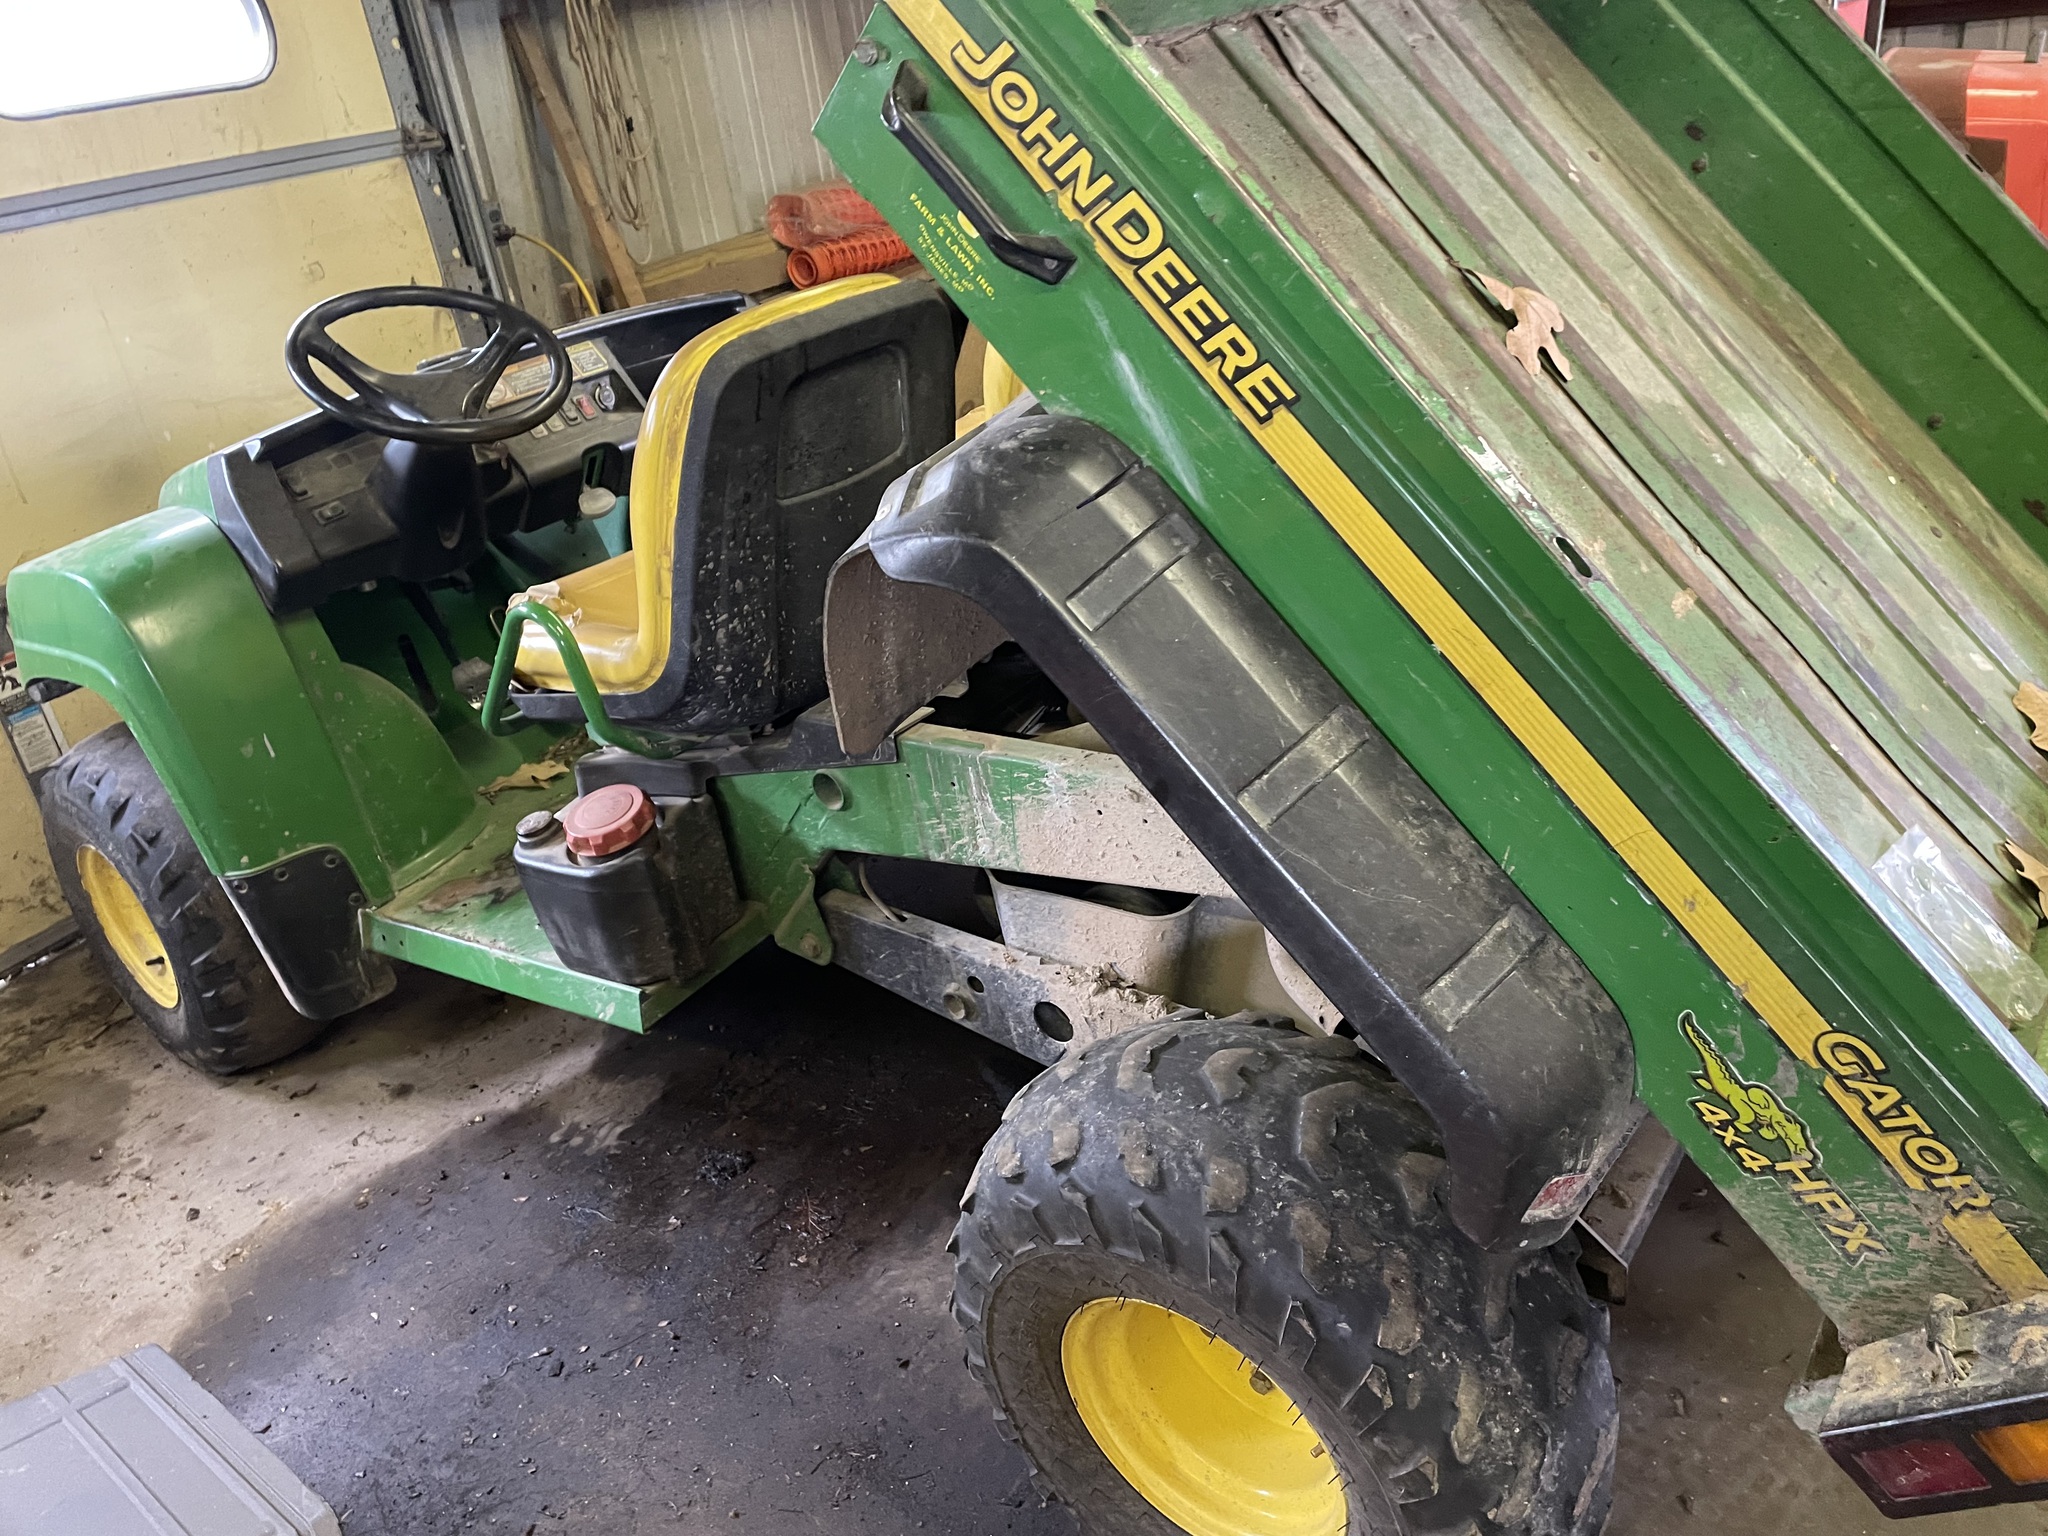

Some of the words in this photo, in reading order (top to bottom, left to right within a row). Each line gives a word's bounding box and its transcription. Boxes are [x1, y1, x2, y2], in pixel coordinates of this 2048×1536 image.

[909, 192, 937, 226] FARM
[936, 226, 945, 237] &
[945, 236, 974, 277] LAWN,
[976, 274, 995, 301] INC.
[940, 213, 959, 237] JOHN
[957, 233, 982, 264] DEERE
[950, 39, 1115, 214] JOHN
[1092, 188, 1299, 423] DEERE
[1694, 1100, 1773, 1173] 4x4
[1775, 1159, 1892, 1254] HPX
[1812, 1029, 1994, 1213] GATOR
